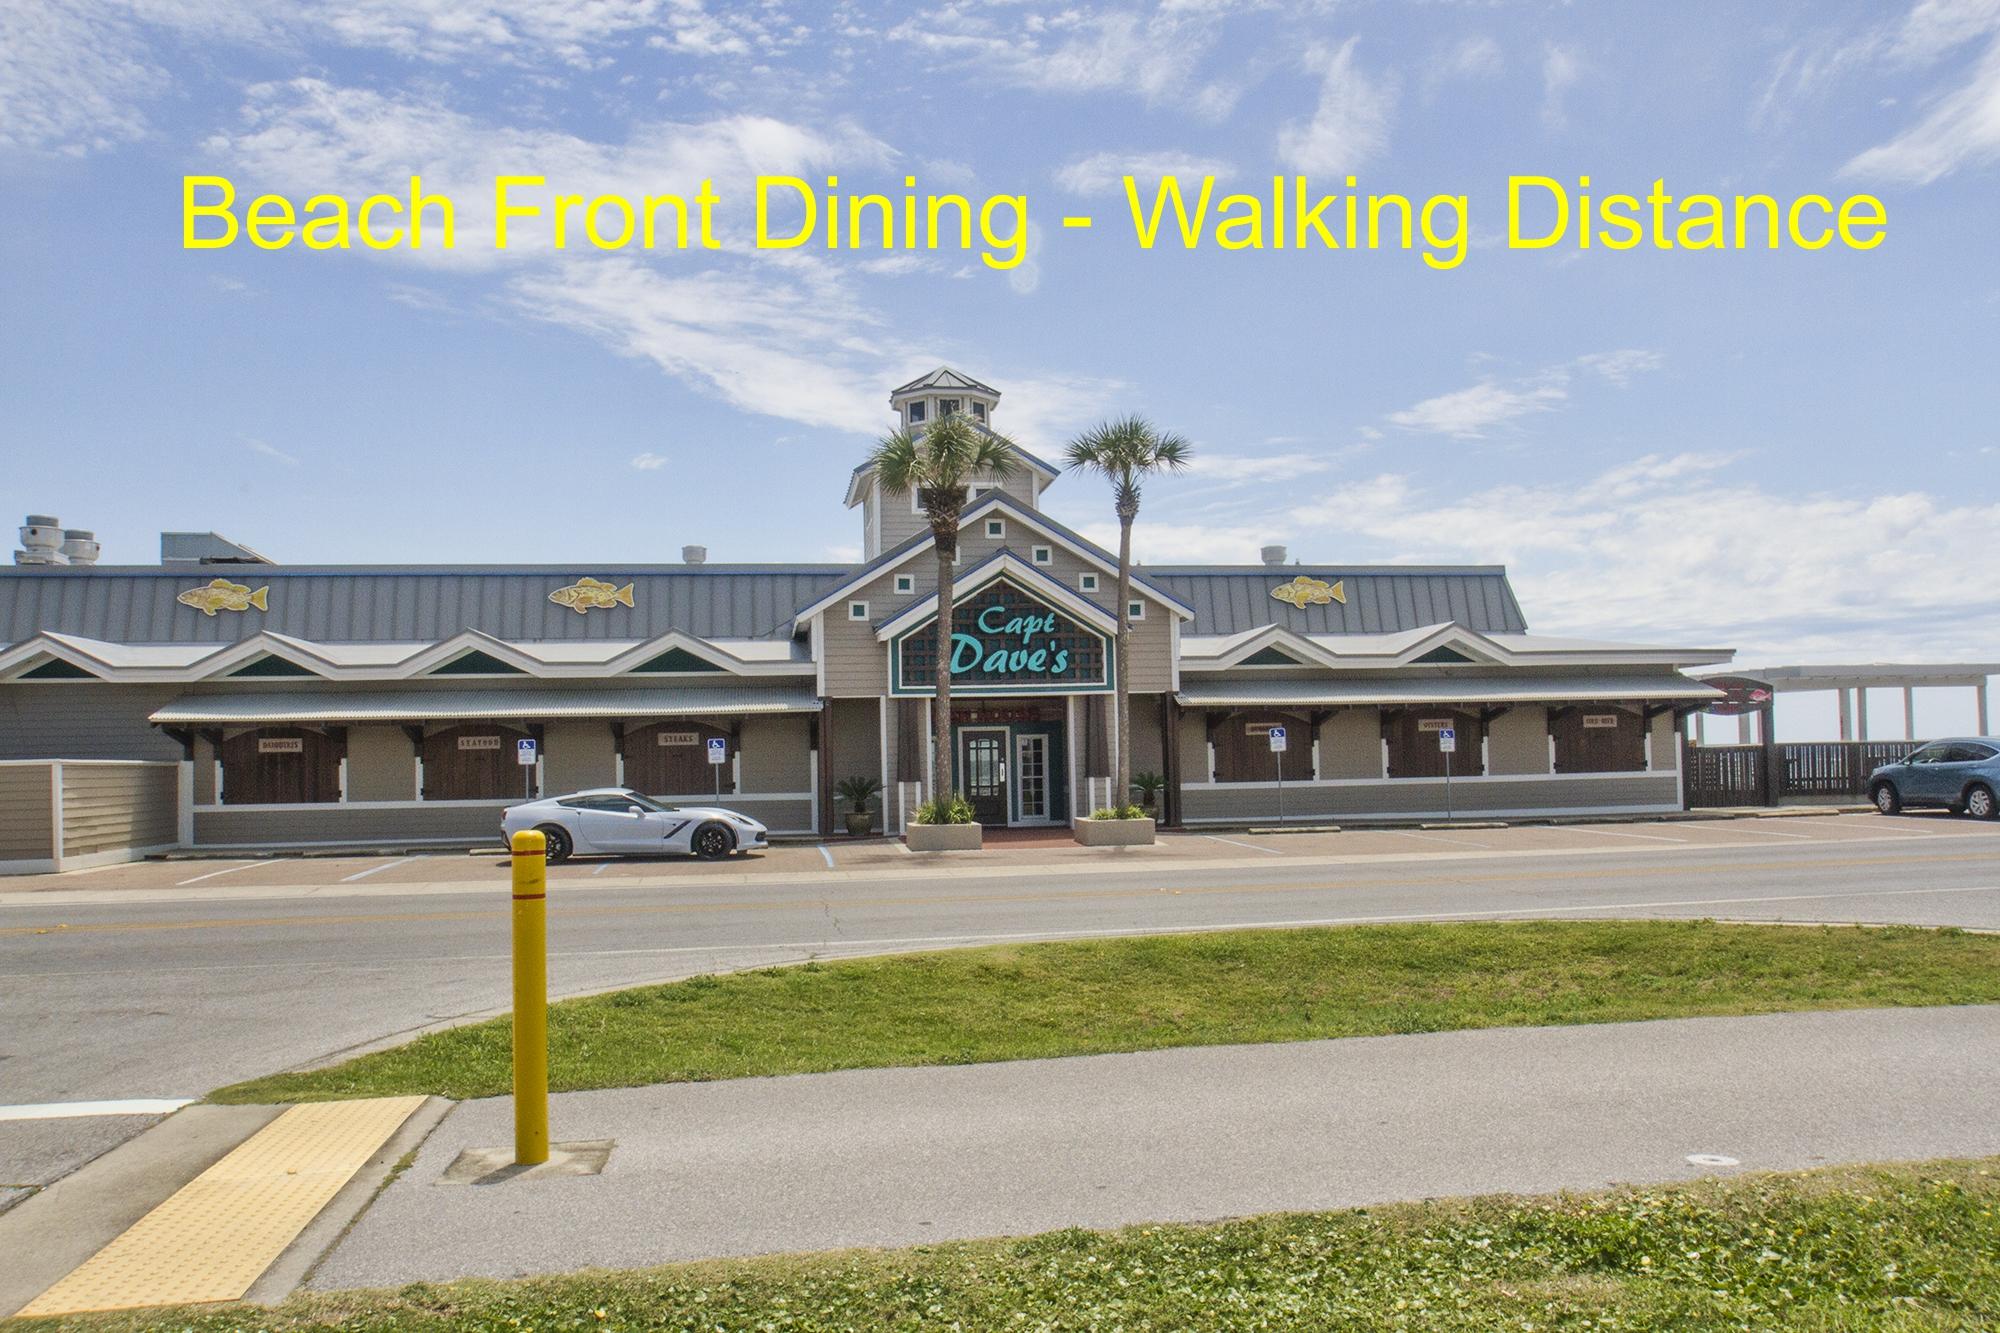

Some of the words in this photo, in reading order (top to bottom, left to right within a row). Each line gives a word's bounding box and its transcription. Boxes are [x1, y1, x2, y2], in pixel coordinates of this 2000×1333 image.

[977, 606, 1056, 645] Capt
[950, 633, 1069, 674] Dave's
[460, 739, 499, 747] SEAFOOD
[663, 734, 694, 743] STEAKS
